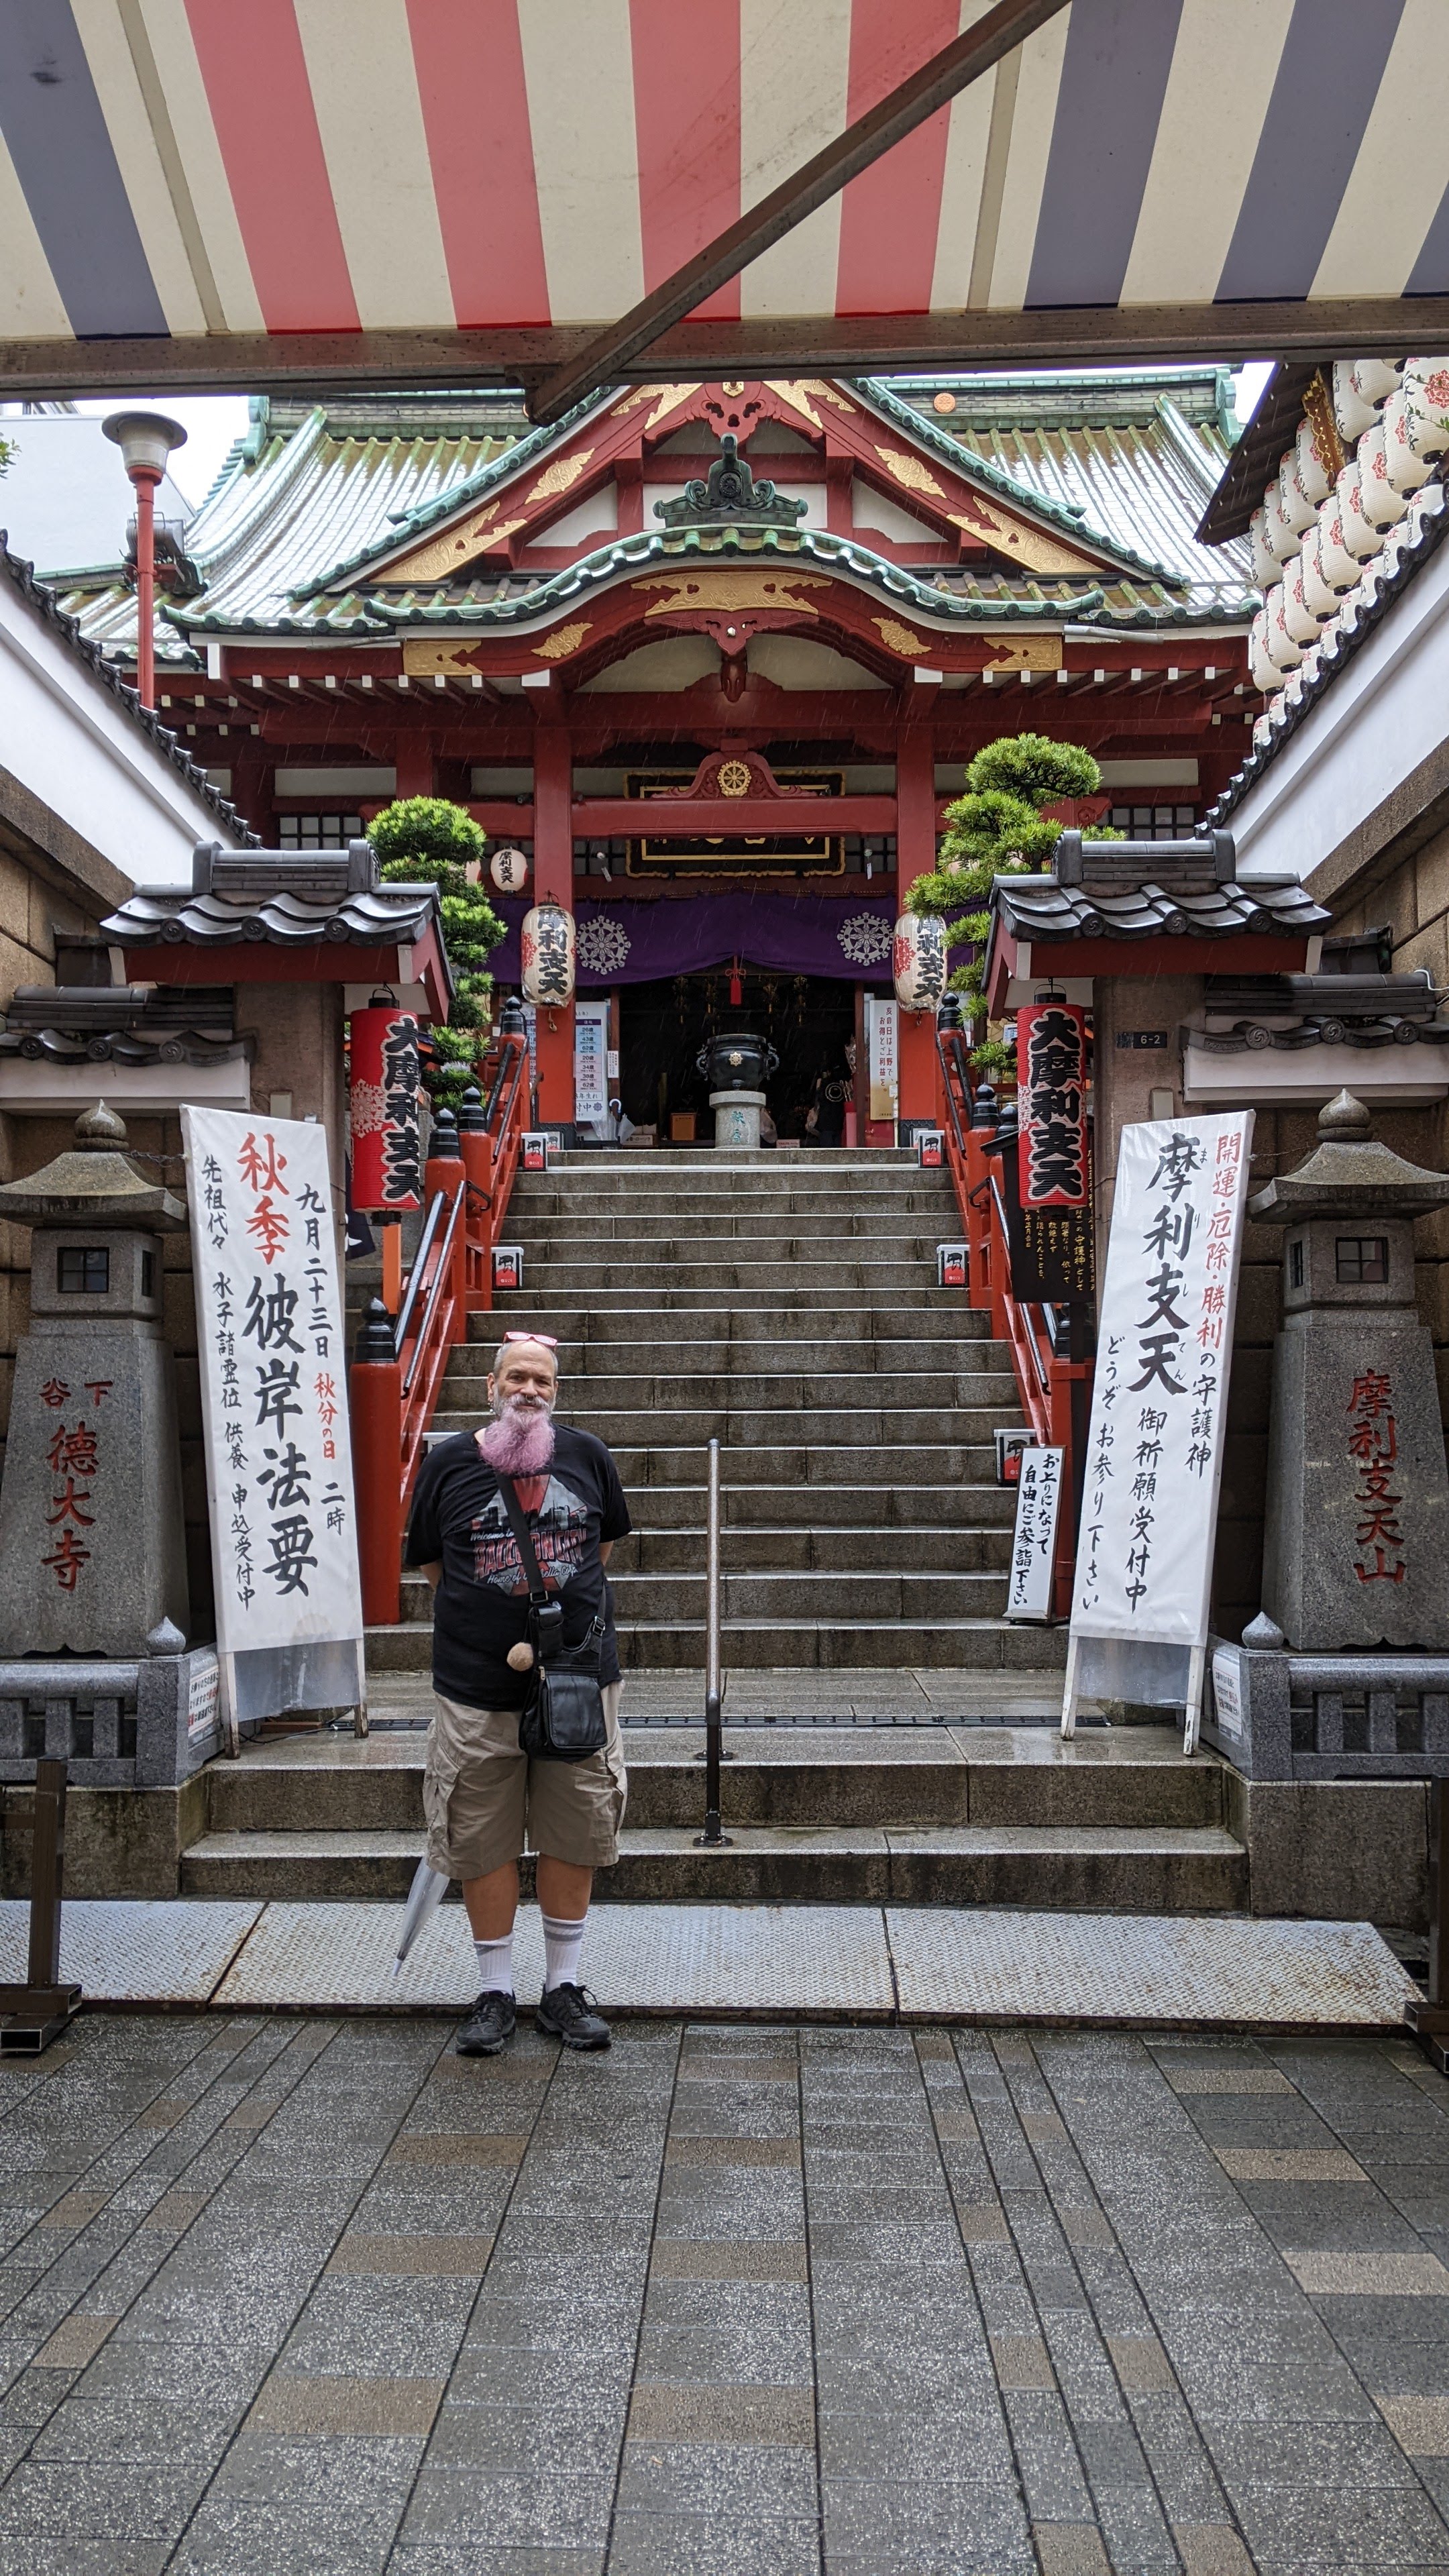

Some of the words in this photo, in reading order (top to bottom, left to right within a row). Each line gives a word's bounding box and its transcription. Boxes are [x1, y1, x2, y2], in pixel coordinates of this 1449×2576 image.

[498, 851, 514, 883] 摩利支天
[537, 908, 568, 995] 摩利支天
[1140, 1034, 1161, 1044] 6-2
[1030, 1012, 1083, 1197] 大摩利支天
[1199, 1149, 1208, 1164] ま
[201, 1154, 229, 1250] 先祖代々
[1194, 1213, 1200, 1229] り
[294, 1183, 333, 1358] 九月二十三日
[1126, 1132, 1202, 1396] 摩利支天
[1182, 1283, 1189, 1297] し
[1184, 1134, 1241, 1480] 開運・厄除・勝利の守護神
[236, 1131, 318, 1597] 秋季彼岸法要
[1102, 1334, 1126, 1411] どうぞ
[225, 1421, 247, 1470] 供養
[313, 1372, 339, 1460] 秋分の日
[320, 1481, 345, 1536] 二時
[1082, 1422, 1115, 1611] お参り下さい
[1124, 1407, 1168, 1614] 御祈願受付中
[1346, 1367, 1407, 1584] 摩利支天山
[230, 1483, 256, 1612] 申込受付中
[470, 1530, 506, 1542] Welcome
[505, 1527, 515, 1538] to
[474, 1532, 555, 1580] RACCON
[1013, 1464, 1038, 1606] 自由にご参詣下さい
[486, 1573, 512, 1585] Home
[512, 1572, 522, 1585] of
